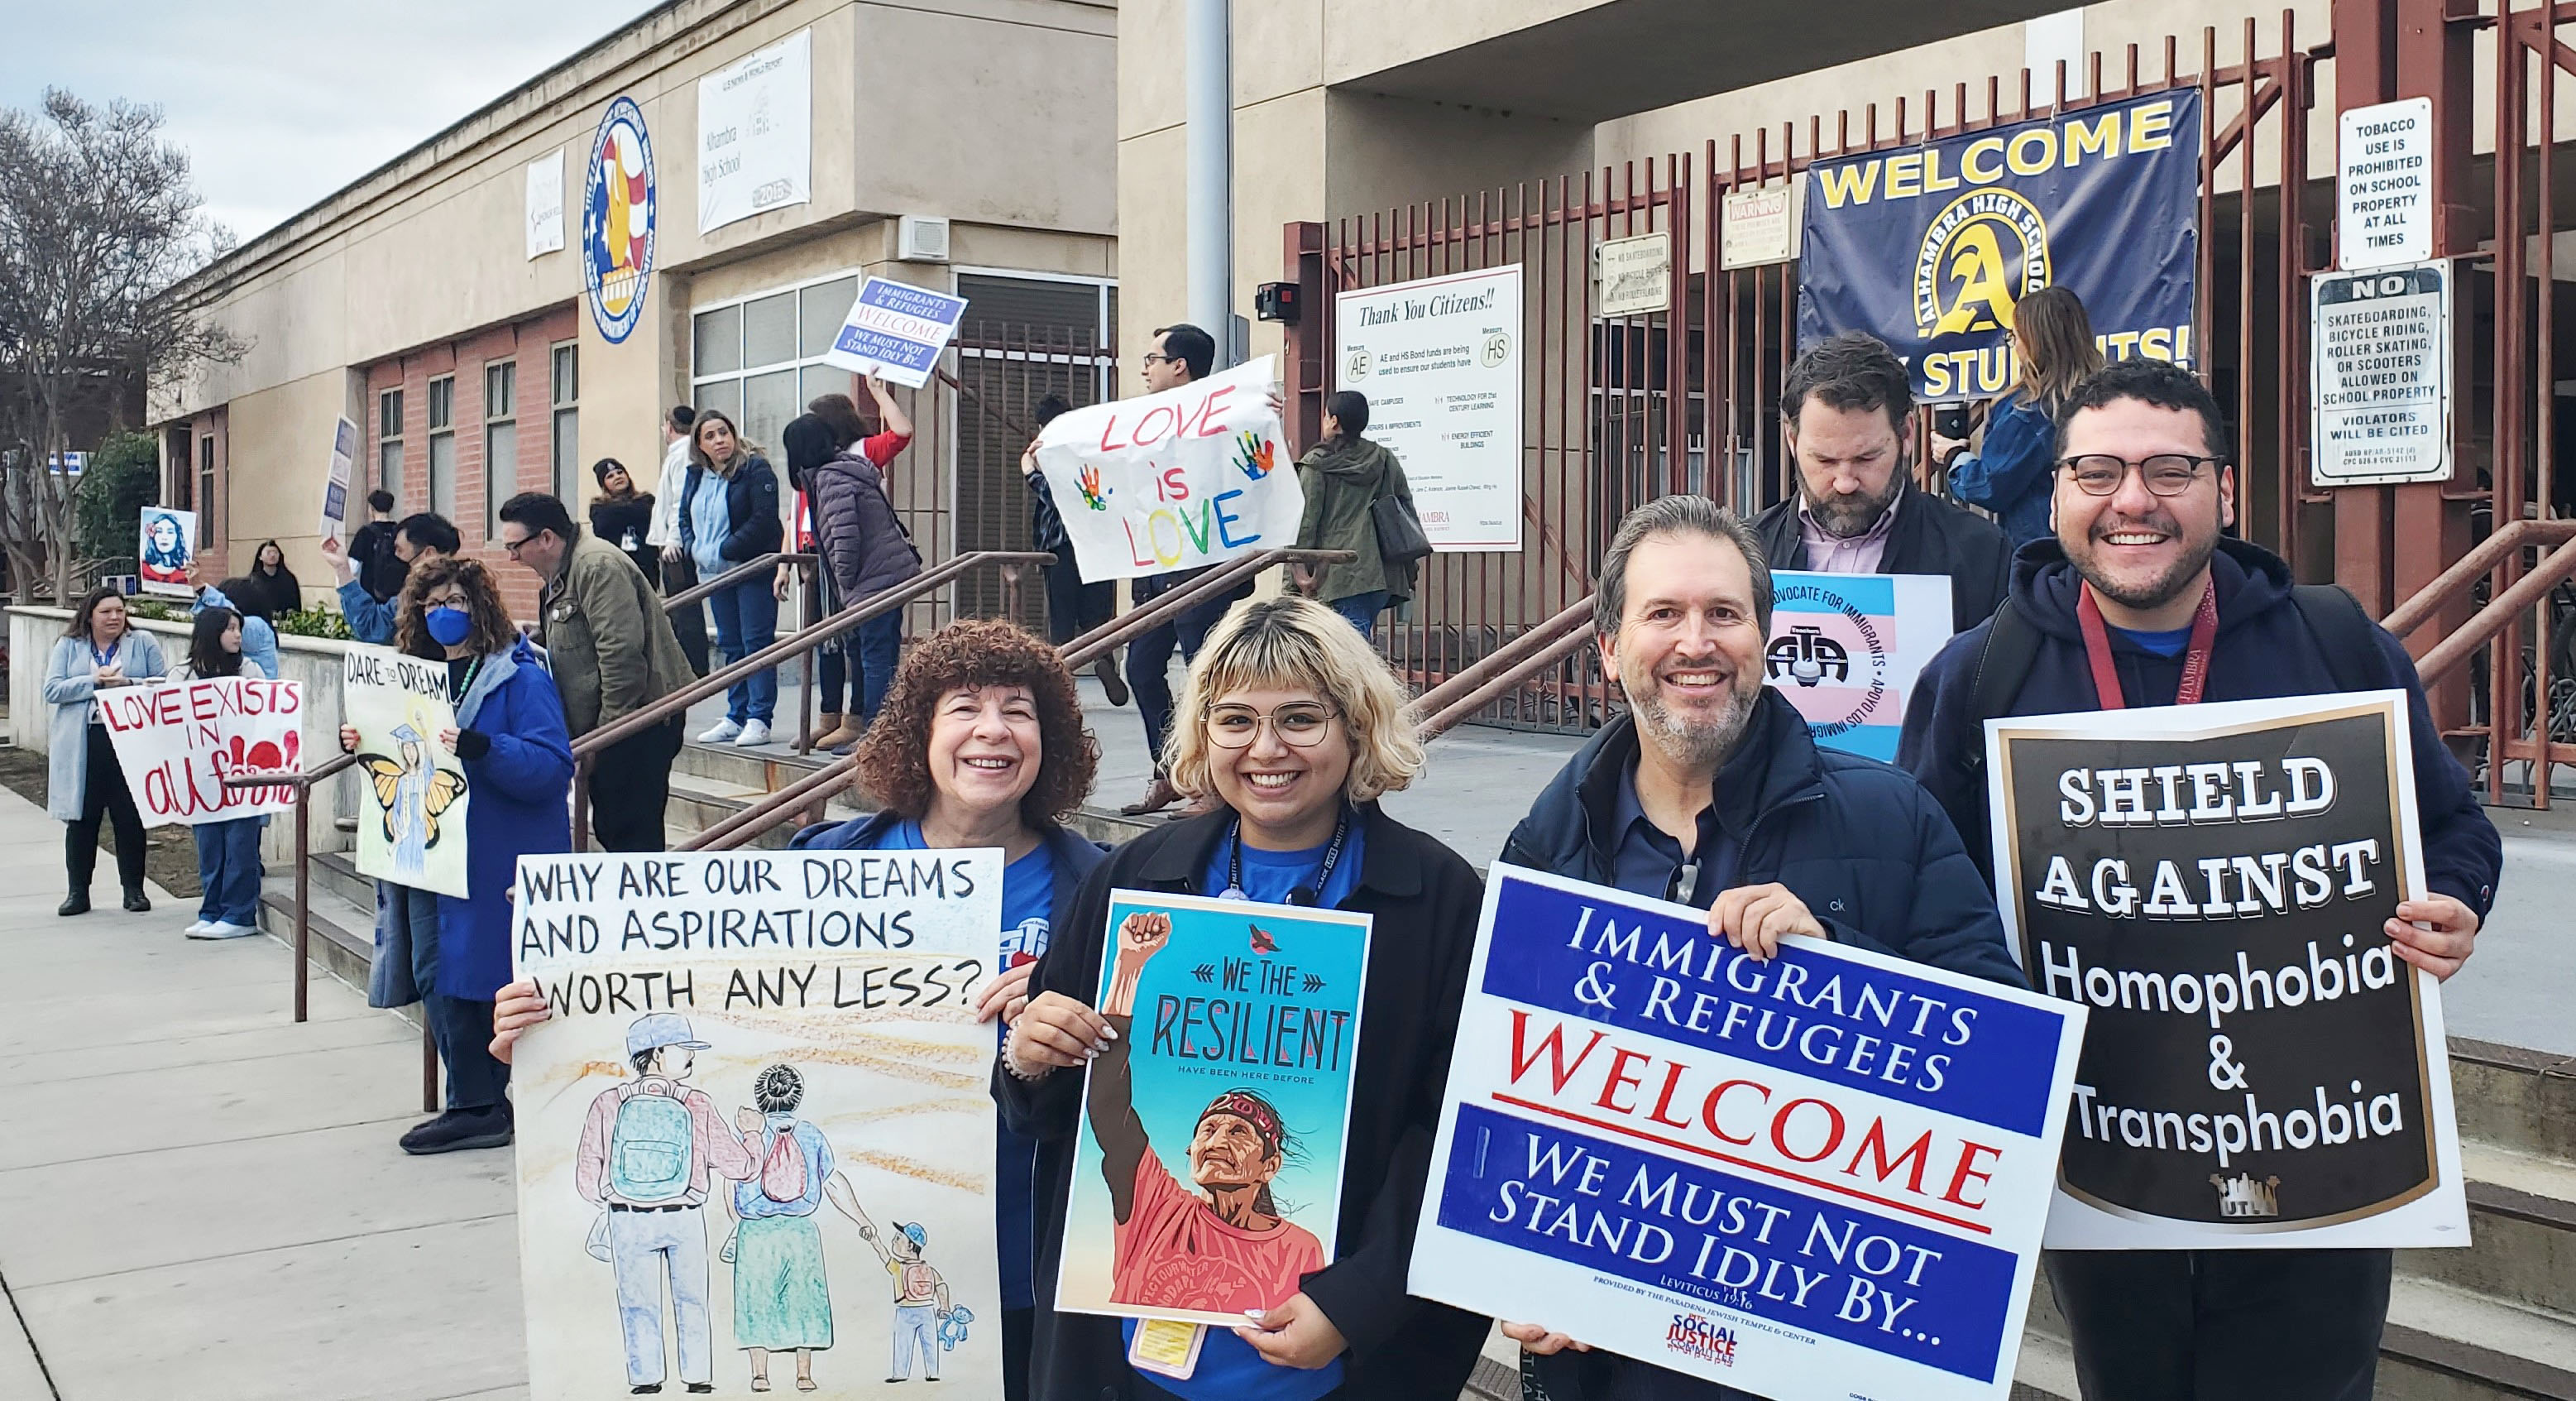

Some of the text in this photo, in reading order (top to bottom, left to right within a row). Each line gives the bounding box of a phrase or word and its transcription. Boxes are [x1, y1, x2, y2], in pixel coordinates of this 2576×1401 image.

[706, 126, 736, 152] Alhambra
[2356, 118, 2415, 138] TOBACCO
[1819, 100, 2173, 209] WELCOME
[2366, 139, 2405, 156] USE IS
[719, 151, 740, 179] School
[2349, 156, 2423, 177] PROHIBITED
[759, 183, 784, 205] 2015
[2350, 175, 2420, 195] ON SCHOOL
[1731, 199, 1783, 220] WARNING
[2353, 194, 2417, 214] PROPERTY
[2364, 213, 2406, 229] AT ALL
[2367, 233, 2404, 248] TIMES
[1919, 194, 2044, 323] ALHAMBRA HIGH SCHOO
[877, 284, 950, 310] IMMIGRANTS
[2352, 276, 2405, 299] NO
[875, 295, 941, 319] & REFUGEES
[1359, 287, 1495, 327] Thank You Citizens!!
[2328, 306, 2431, 327] SKATEBOARDING,
[857, 305, 943, 341] WELCOME
[2329, 323, 2430, 343] BICYCLE RIDING,
[844, 338, 879, 355] STAND
[879, 348, 905, 362] IDLY
[855, 329, 926, 357] WE MUST NOT
[1380, 354, 1388, 362] AE
[1389, 352, 1400, 362] and
[1401, 351, 1410, 360] HS
[1410, 349, 1425, 359] Bond
[1426, 349, 1442, 357] funds
[1453, 345, 1469, 355] being
[1487, 339, 1506, 360] HS
[2327, 338, 2431, 359] ROLLER SKATING,
[1351, 356, 1367, 377] AE
[1378, 367, 1392, 376] used
[1393, 366, 1399, 374] to
[1400, 364, 1420, 373] ensure
[1431, 361, 1456, 370] students
[1457, 358, 1471, 367] have
[1922, 325, 2190, 397] STUTS!
[2337, 354, 2421, 372] OR SCOOTERS
[2341, 371, 2418, 388] ALLOWED ON
[1381, 397, 1403, 405] CAMPUSES
[1447, 394, 1477, 402] TECHNOLOGY
[2323, 385, 2435, 405] SCHOOL PROPERTY
[1101, 385, 1236, 452] LOVE
[2330, 425, 2428, 440] WILL BE CITED
[2342, 412, 2416, 426] VIOLATORS
[1149, 460, 1189, 502] is
[1123, 489, 1262, 568] LOVE
[1774, 586, 1885, 667] DVOCATE FOR IMMIGRANTS
[347, 651, 451, 703] DARE TO DREAM
[103, 680, 299, 732] LOVE EXISTS
[1809, 679, 1884, 737] APOYO LOS INMIGR
[185, 721, 220, 750] IN
[145, 756, 199, 817] all
[2058, 756, 2339, 828] SHIELD
[520, 856, 974, 907] WHY ARE OUR DREAMS
[1318, 868, 1329, 890] BLACK
[1325, 848, 1337, 868] LIVES
[2035, 838, 2382, 922] AGAINST
[1830, 899, 1845, 912] ck
[520, 907, 913, 962] AND ASPIRATIONS
[532, 959, 984, 1020] WORTH ANY LESS?
[1223, 956, 1297, 996] WE THE
[1567, 904, 1979, 1048] IMMIGRANTS
[2041, 933, 2396, 1029] Homophobia
[1151, 995, 1351, 1072] RESILIENT
[1573, 960, 1951, 1092] & REFUGEES
[1178, 1065, 1314, 1084] HAVE BEEN HERE BEFORE
[2208, 1034, 2249, 1091] &
[1506, 1007, 2004, 1211] WELCOME
[2071, 1080, 2404, 1168] Transphobia
[1525, 1133, 1943, 1288] WE MUST NOT
[1489, 1179, 1942, 1346] STAND IDLY BY...
[1660, 1274, 1719, 1300] LEVITICUS
[1593, 1275, 1634, 1292] PROVIDED
[1647, 1291, 1664, 1301] THE
[1665, 1297, 1706, 1313] PASADENA
[1707, 1309, 1738, 1322] JEWISH
[1740, 1318, 1773, 1332] TEMPLE
[1783, 1331, 1817, 1345] CENTER
[1666, 1323, 1735, 1357] JUSTICE
[1673, 1314, 1737, 1345] SOCIAL
